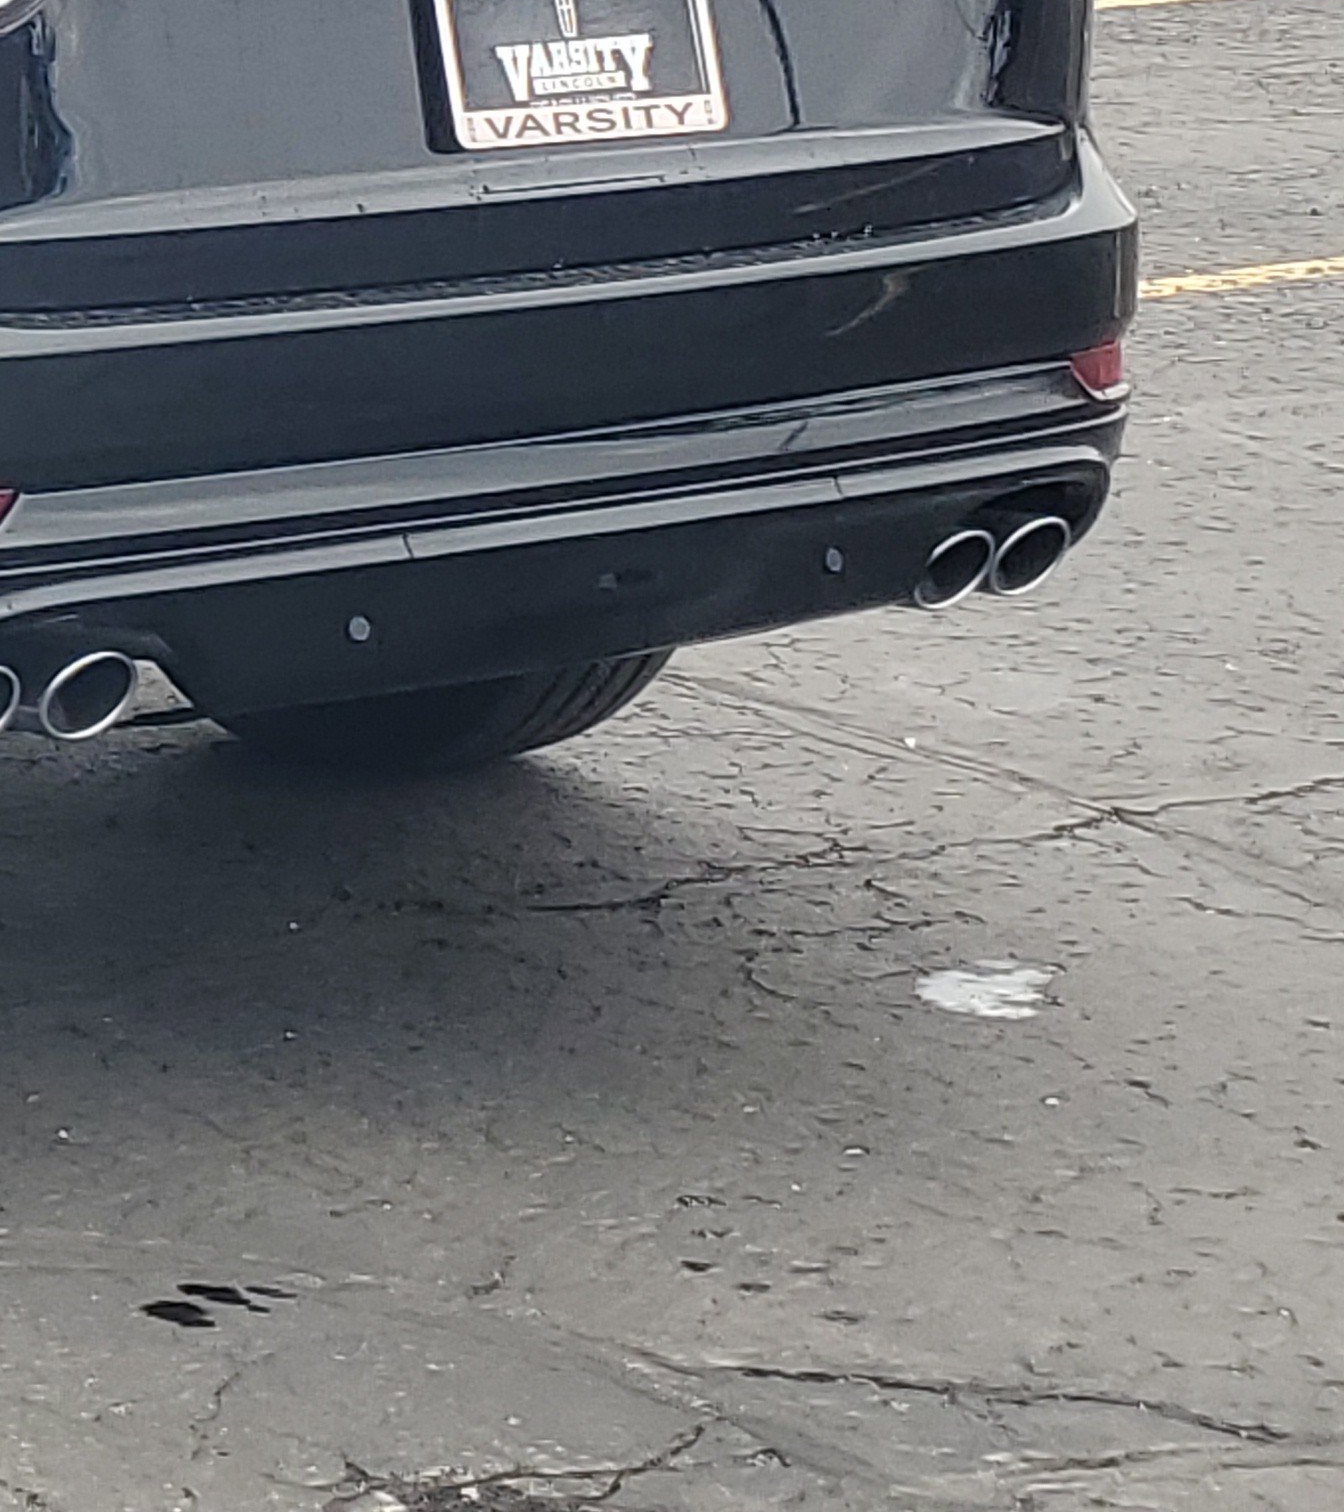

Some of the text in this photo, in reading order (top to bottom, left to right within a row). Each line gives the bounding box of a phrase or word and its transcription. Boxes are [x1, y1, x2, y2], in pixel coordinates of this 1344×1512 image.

[495, 33, 654, 102] VARSITY
[540, 76, 617, 92] LINCOLN
[484, 101, 694, 141] VARSITY
